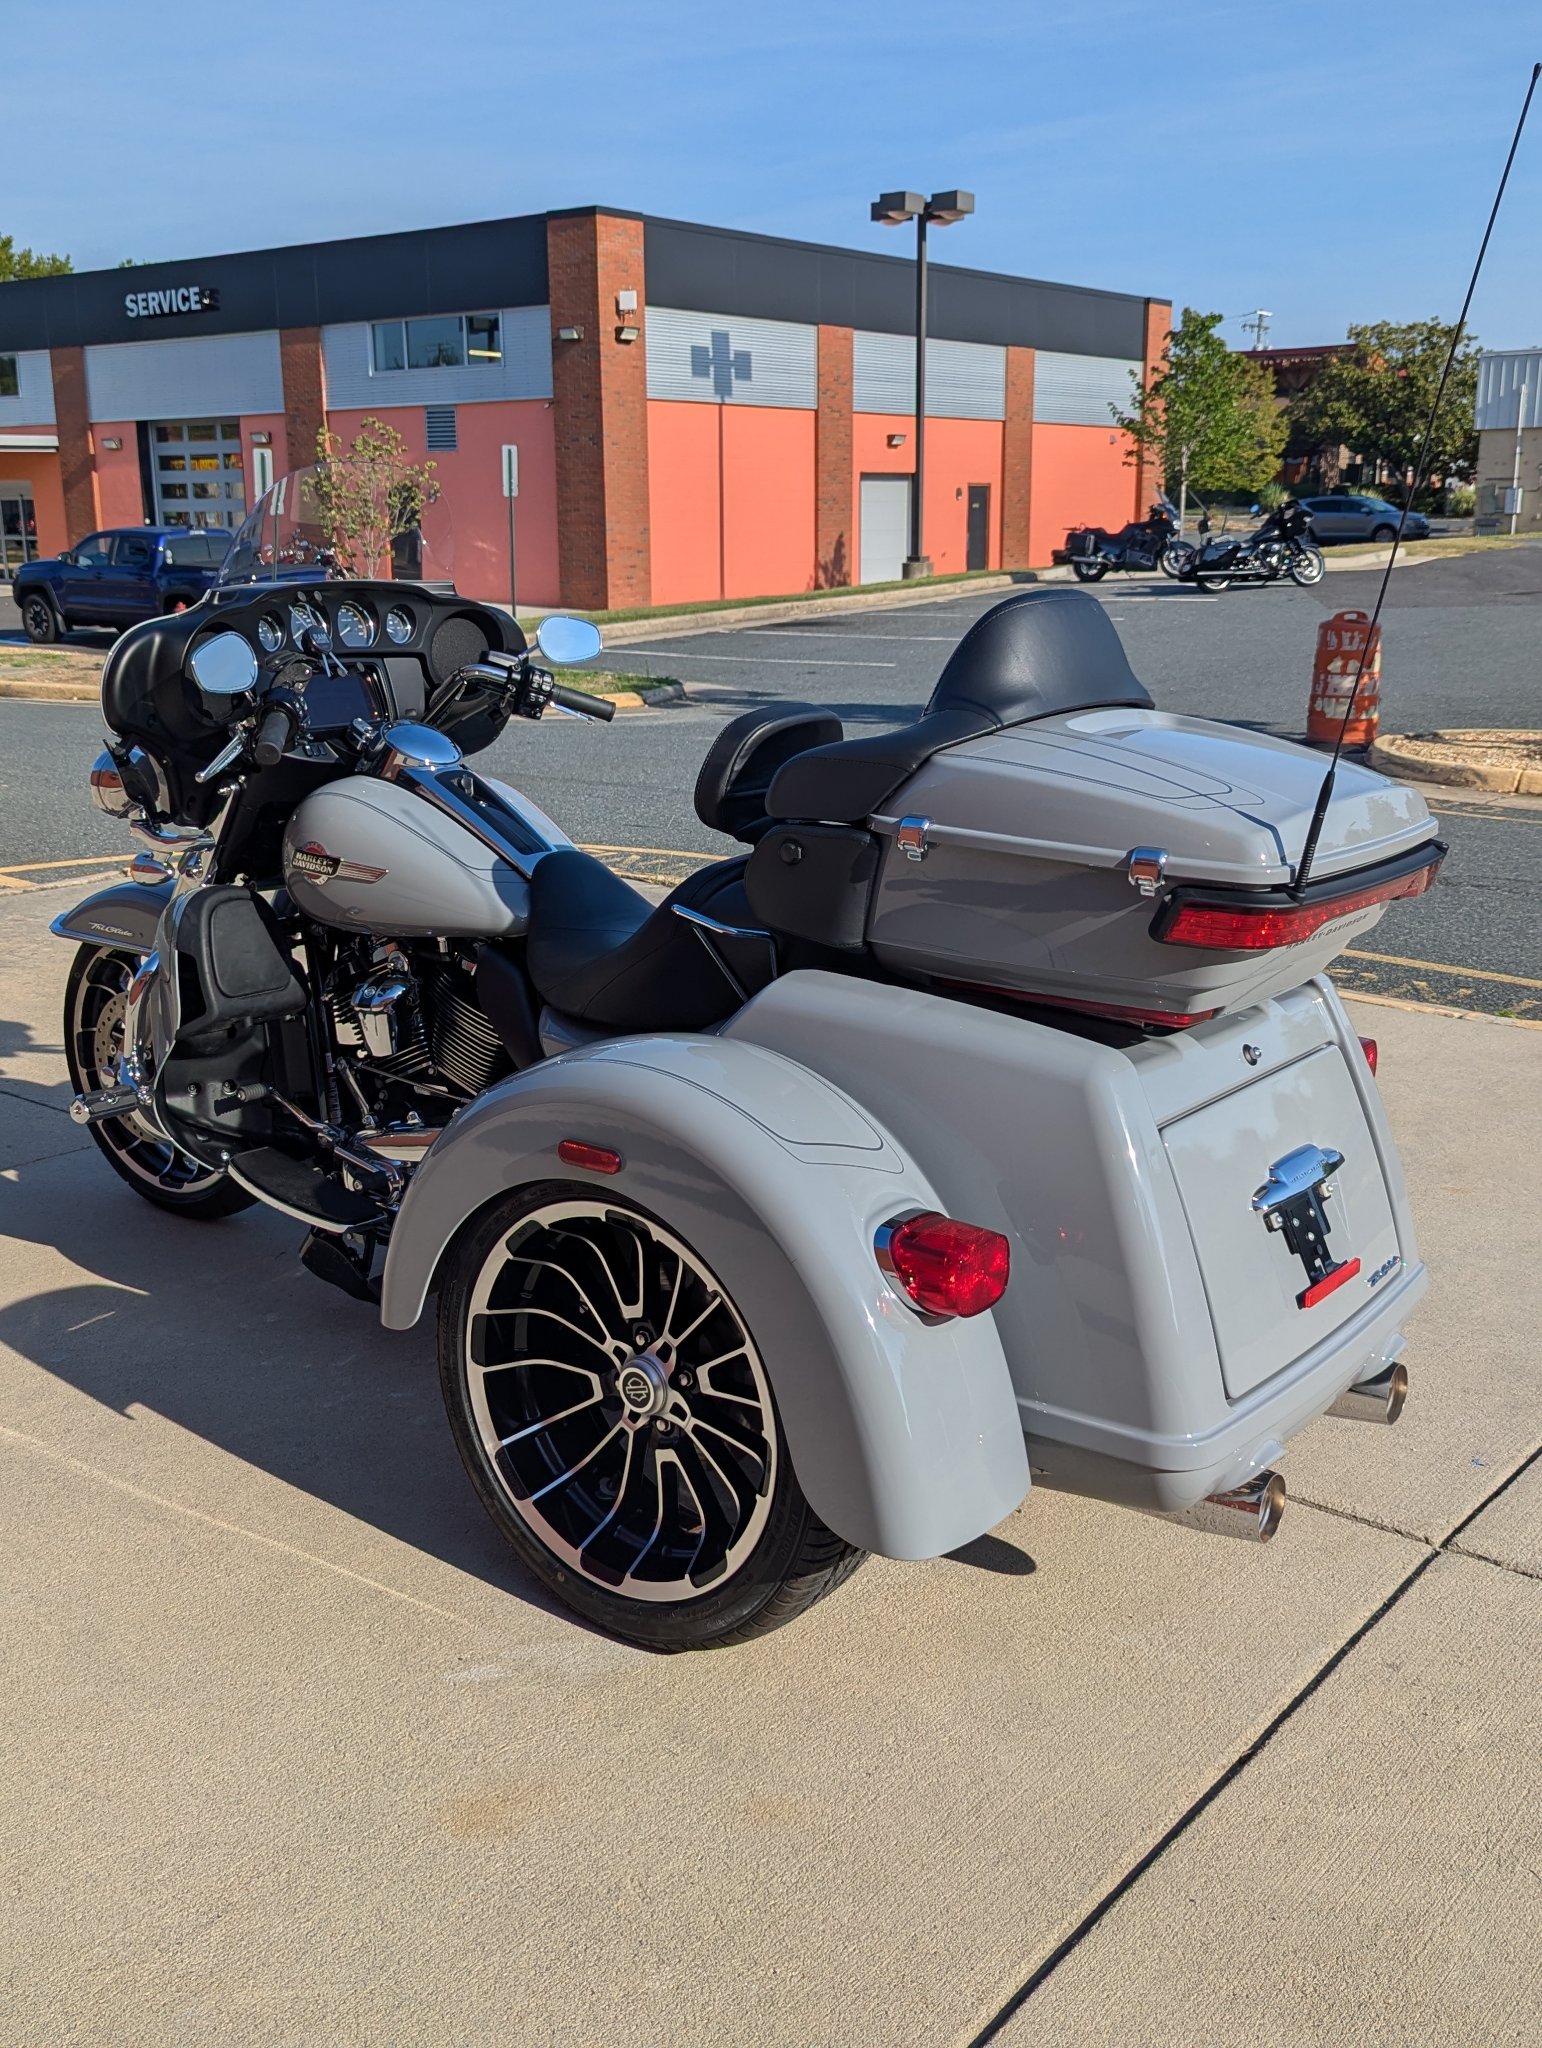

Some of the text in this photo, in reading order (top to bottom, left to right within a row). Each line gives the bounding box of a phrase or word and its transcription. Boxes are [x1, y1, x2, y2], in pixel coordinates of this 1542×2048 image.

[125, 286, 202, 318] SERVICE
[292, 858, 334, 875] DAVIDSON
[296, 851, 333, 867] HARLEY-
